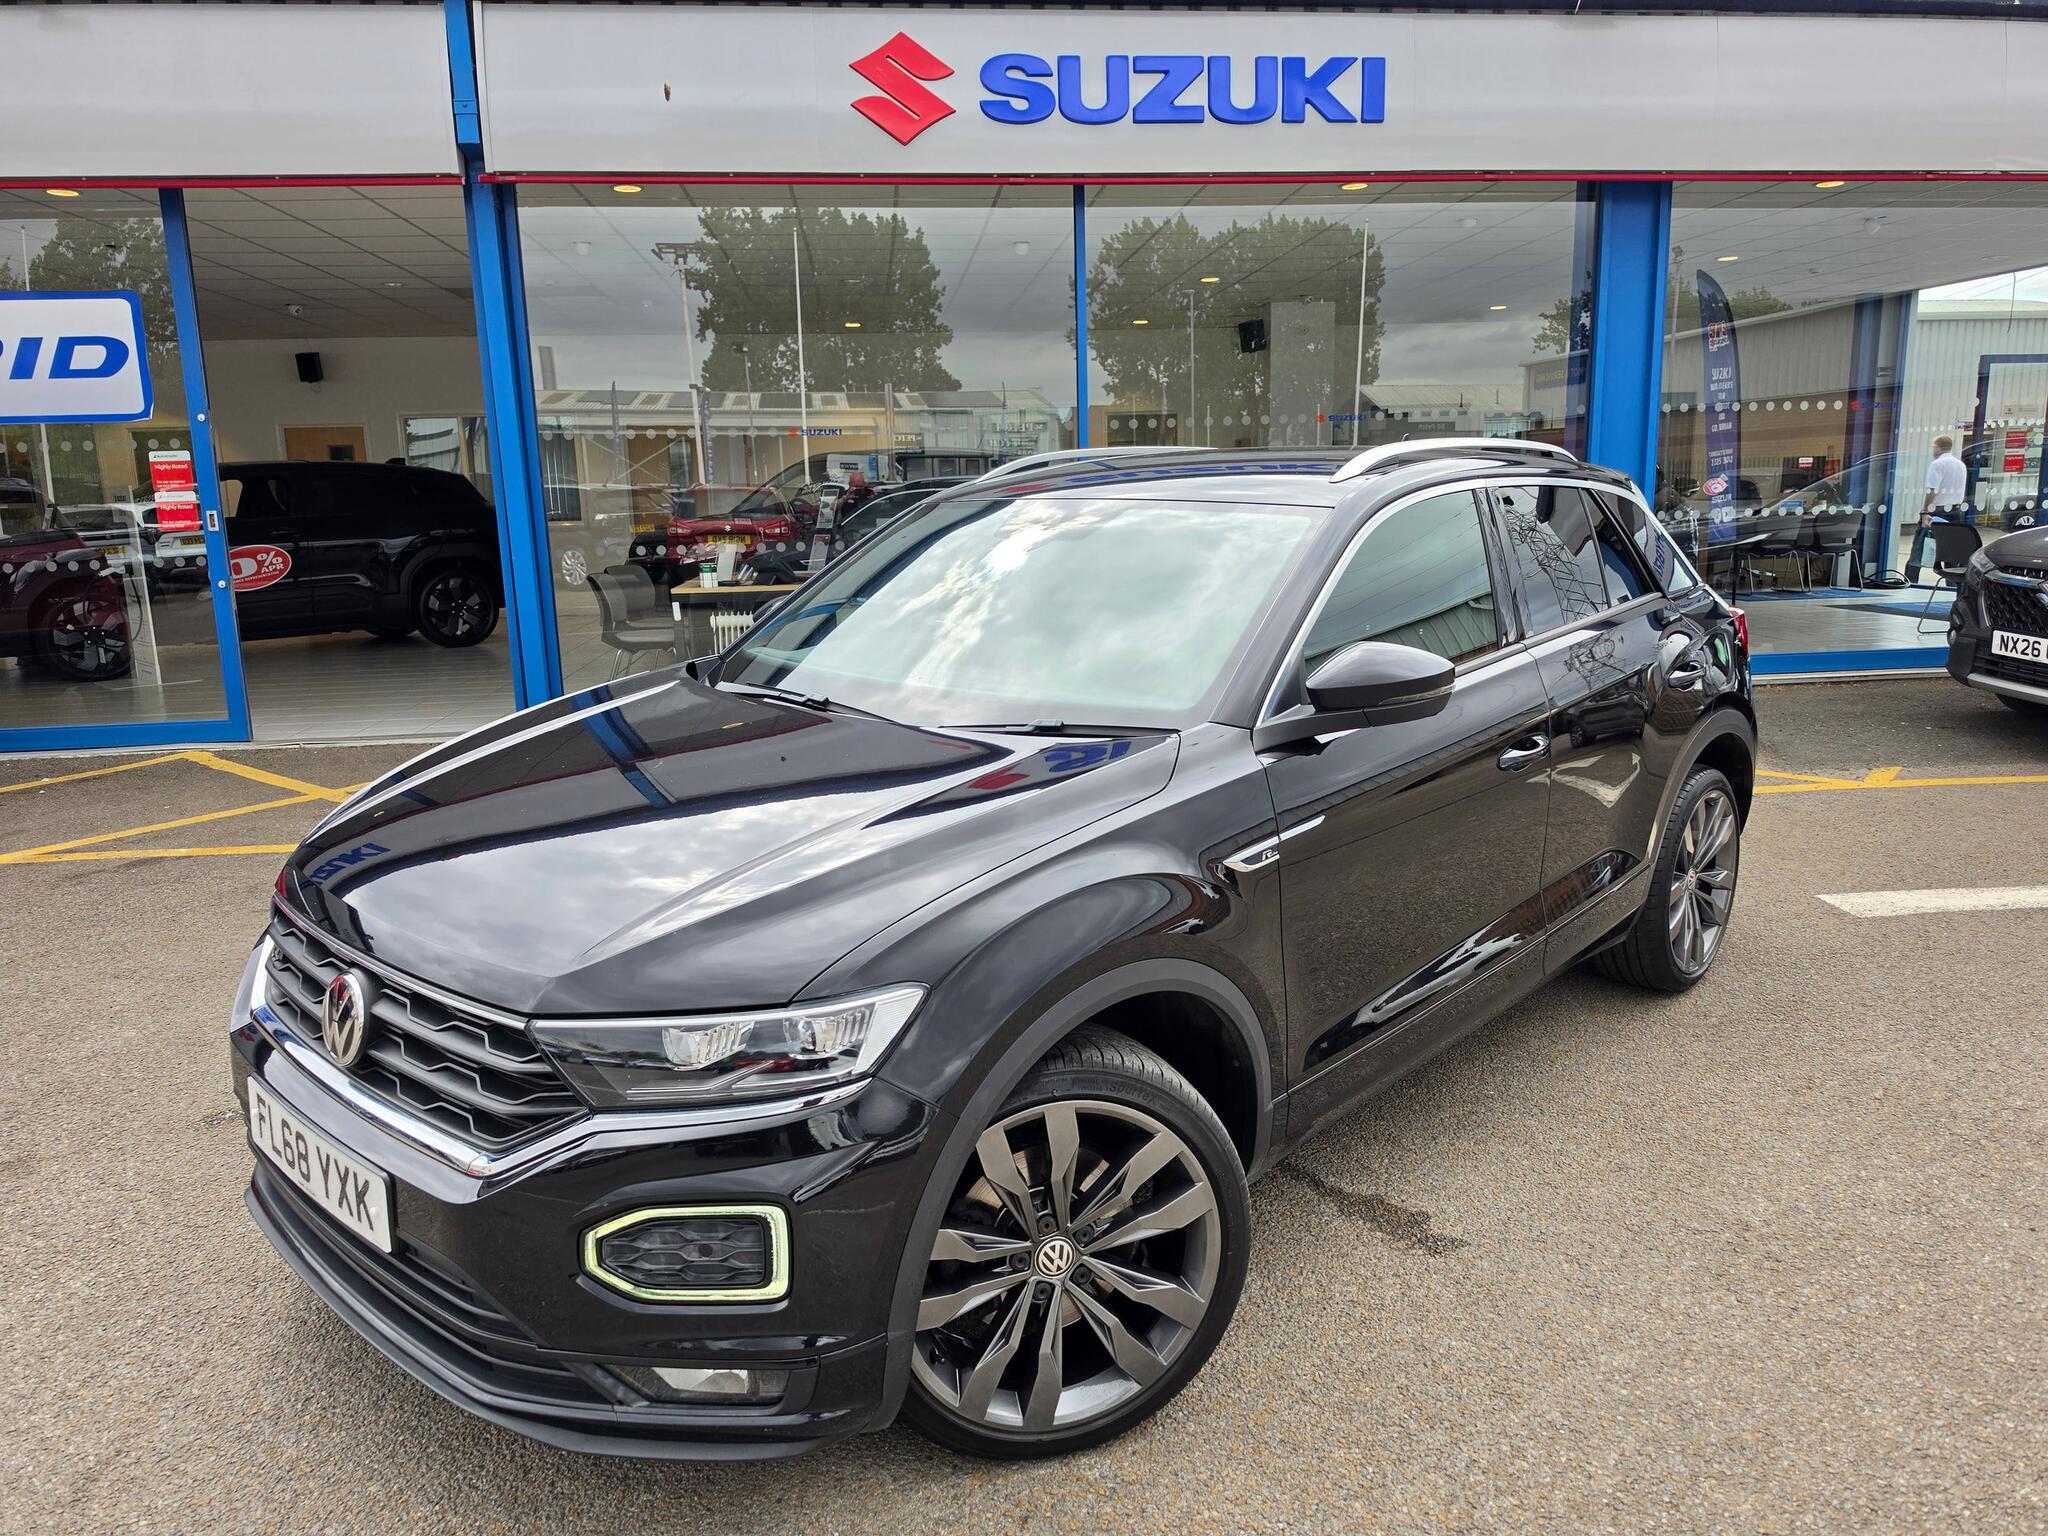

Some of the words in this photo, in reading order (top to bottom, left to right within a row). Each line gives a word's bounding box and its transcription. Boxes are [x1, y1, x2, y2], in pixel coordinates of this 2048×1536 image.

[979, 52, 1386, 125] SUZUKI
[0, 335, 130, 380] ID
[801, 428, 842, 436] SUZUKI
[154, 463, 171, 471] Highly
[261, 563, 284, 574] APR
[1999, 634, 2042, 658] NX26
[256, 1092, 311, 1184] FL68
[316, 1144, 375, 1233] YXK
